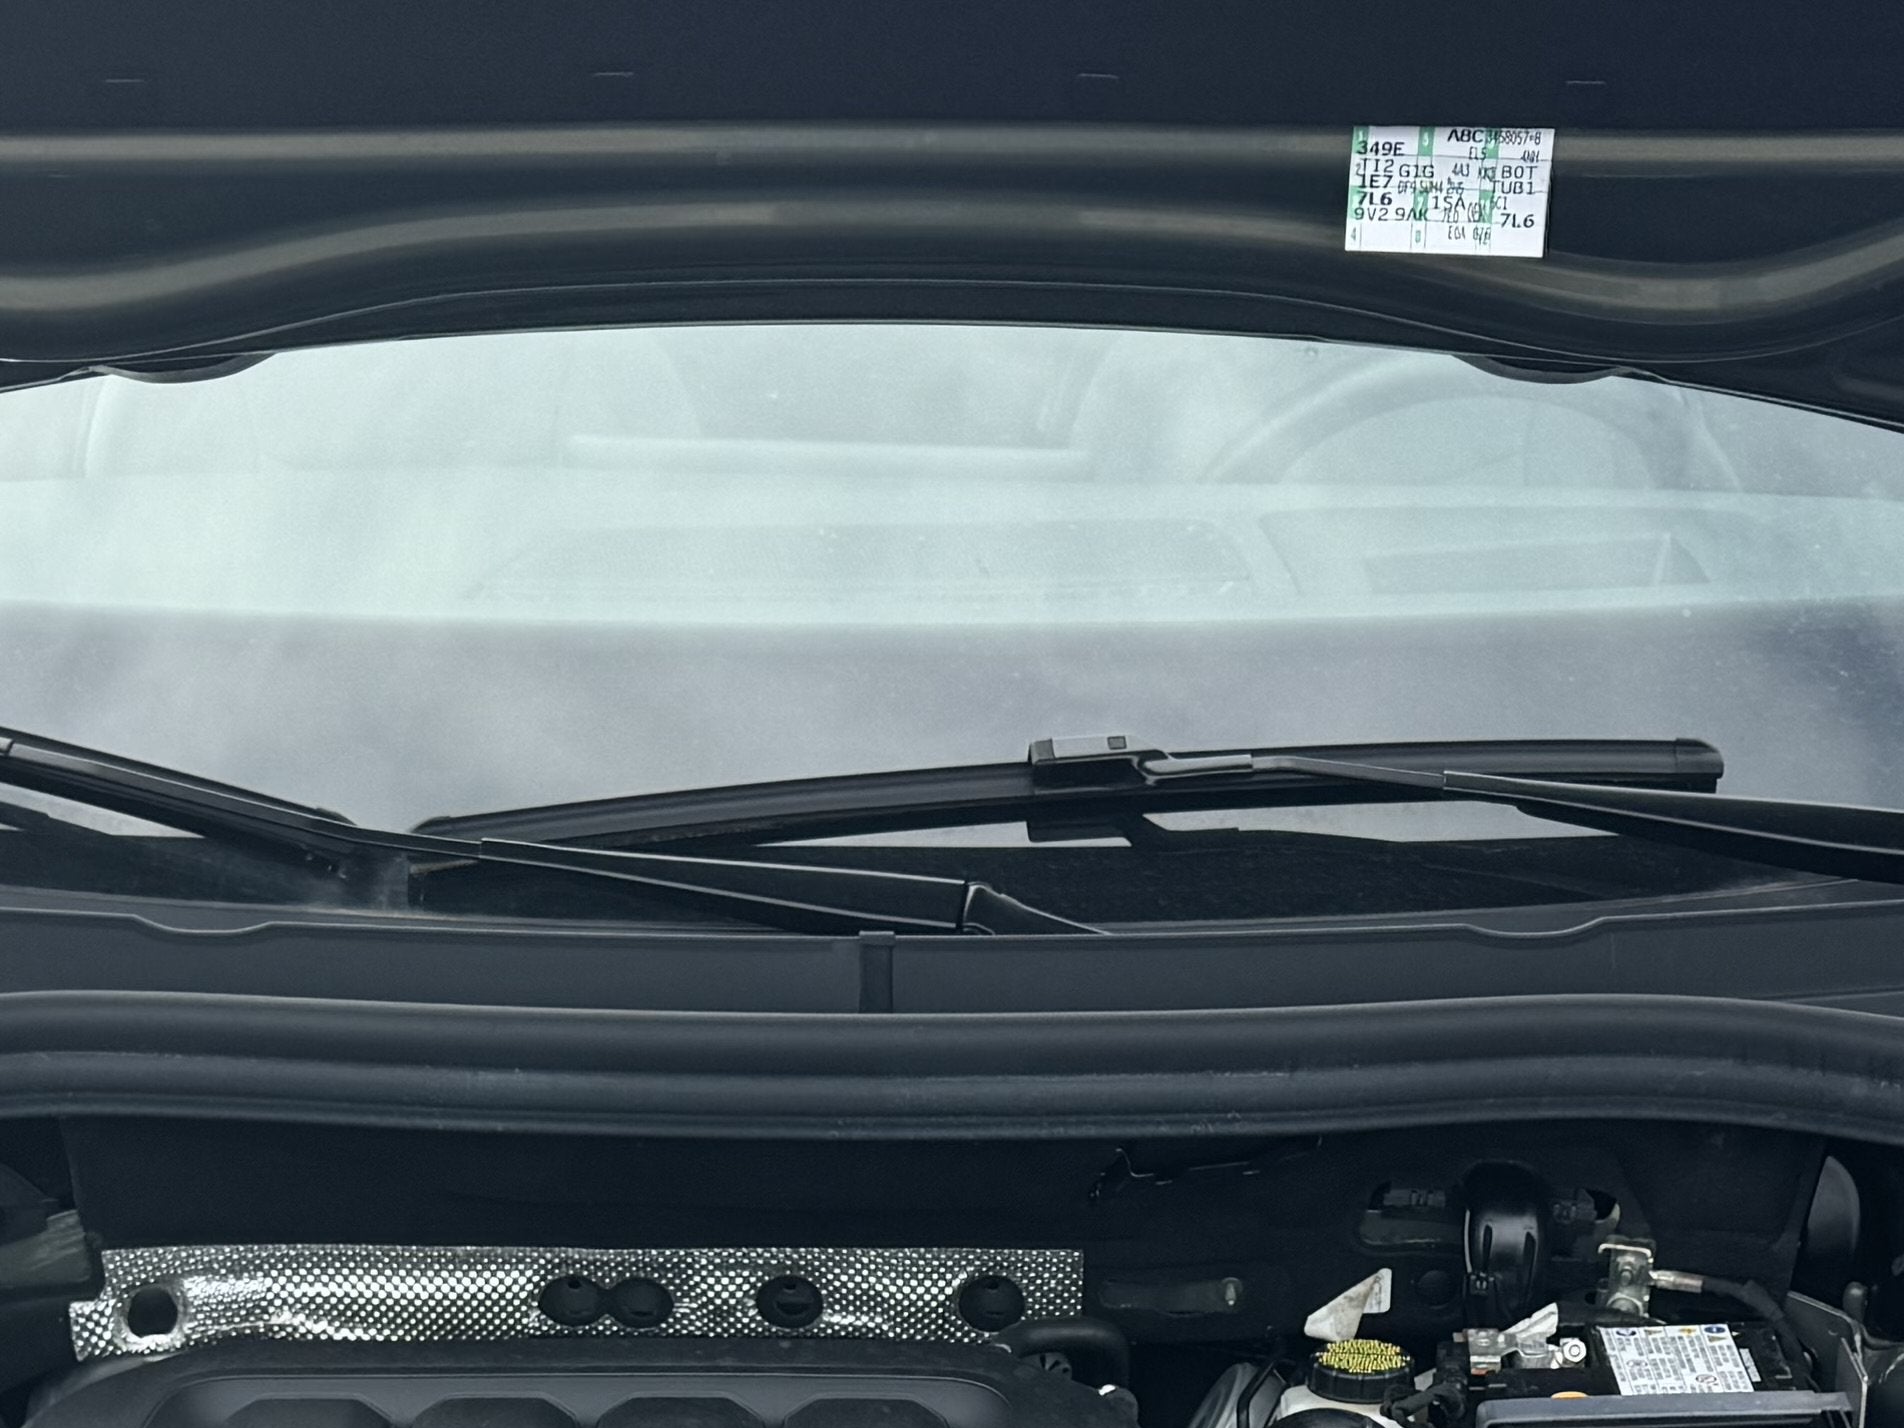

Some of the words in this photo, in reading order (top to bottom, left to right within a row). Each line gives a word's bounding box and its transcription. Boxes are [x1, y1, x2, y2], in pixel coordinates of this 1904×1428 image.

[1448, 129, 1484, 143] ABC
[1356, 141, 1405, 156] 349E
[1357, 191, 1392, 206] 7L6
[1354, 207, 1388, 221] 9V2
